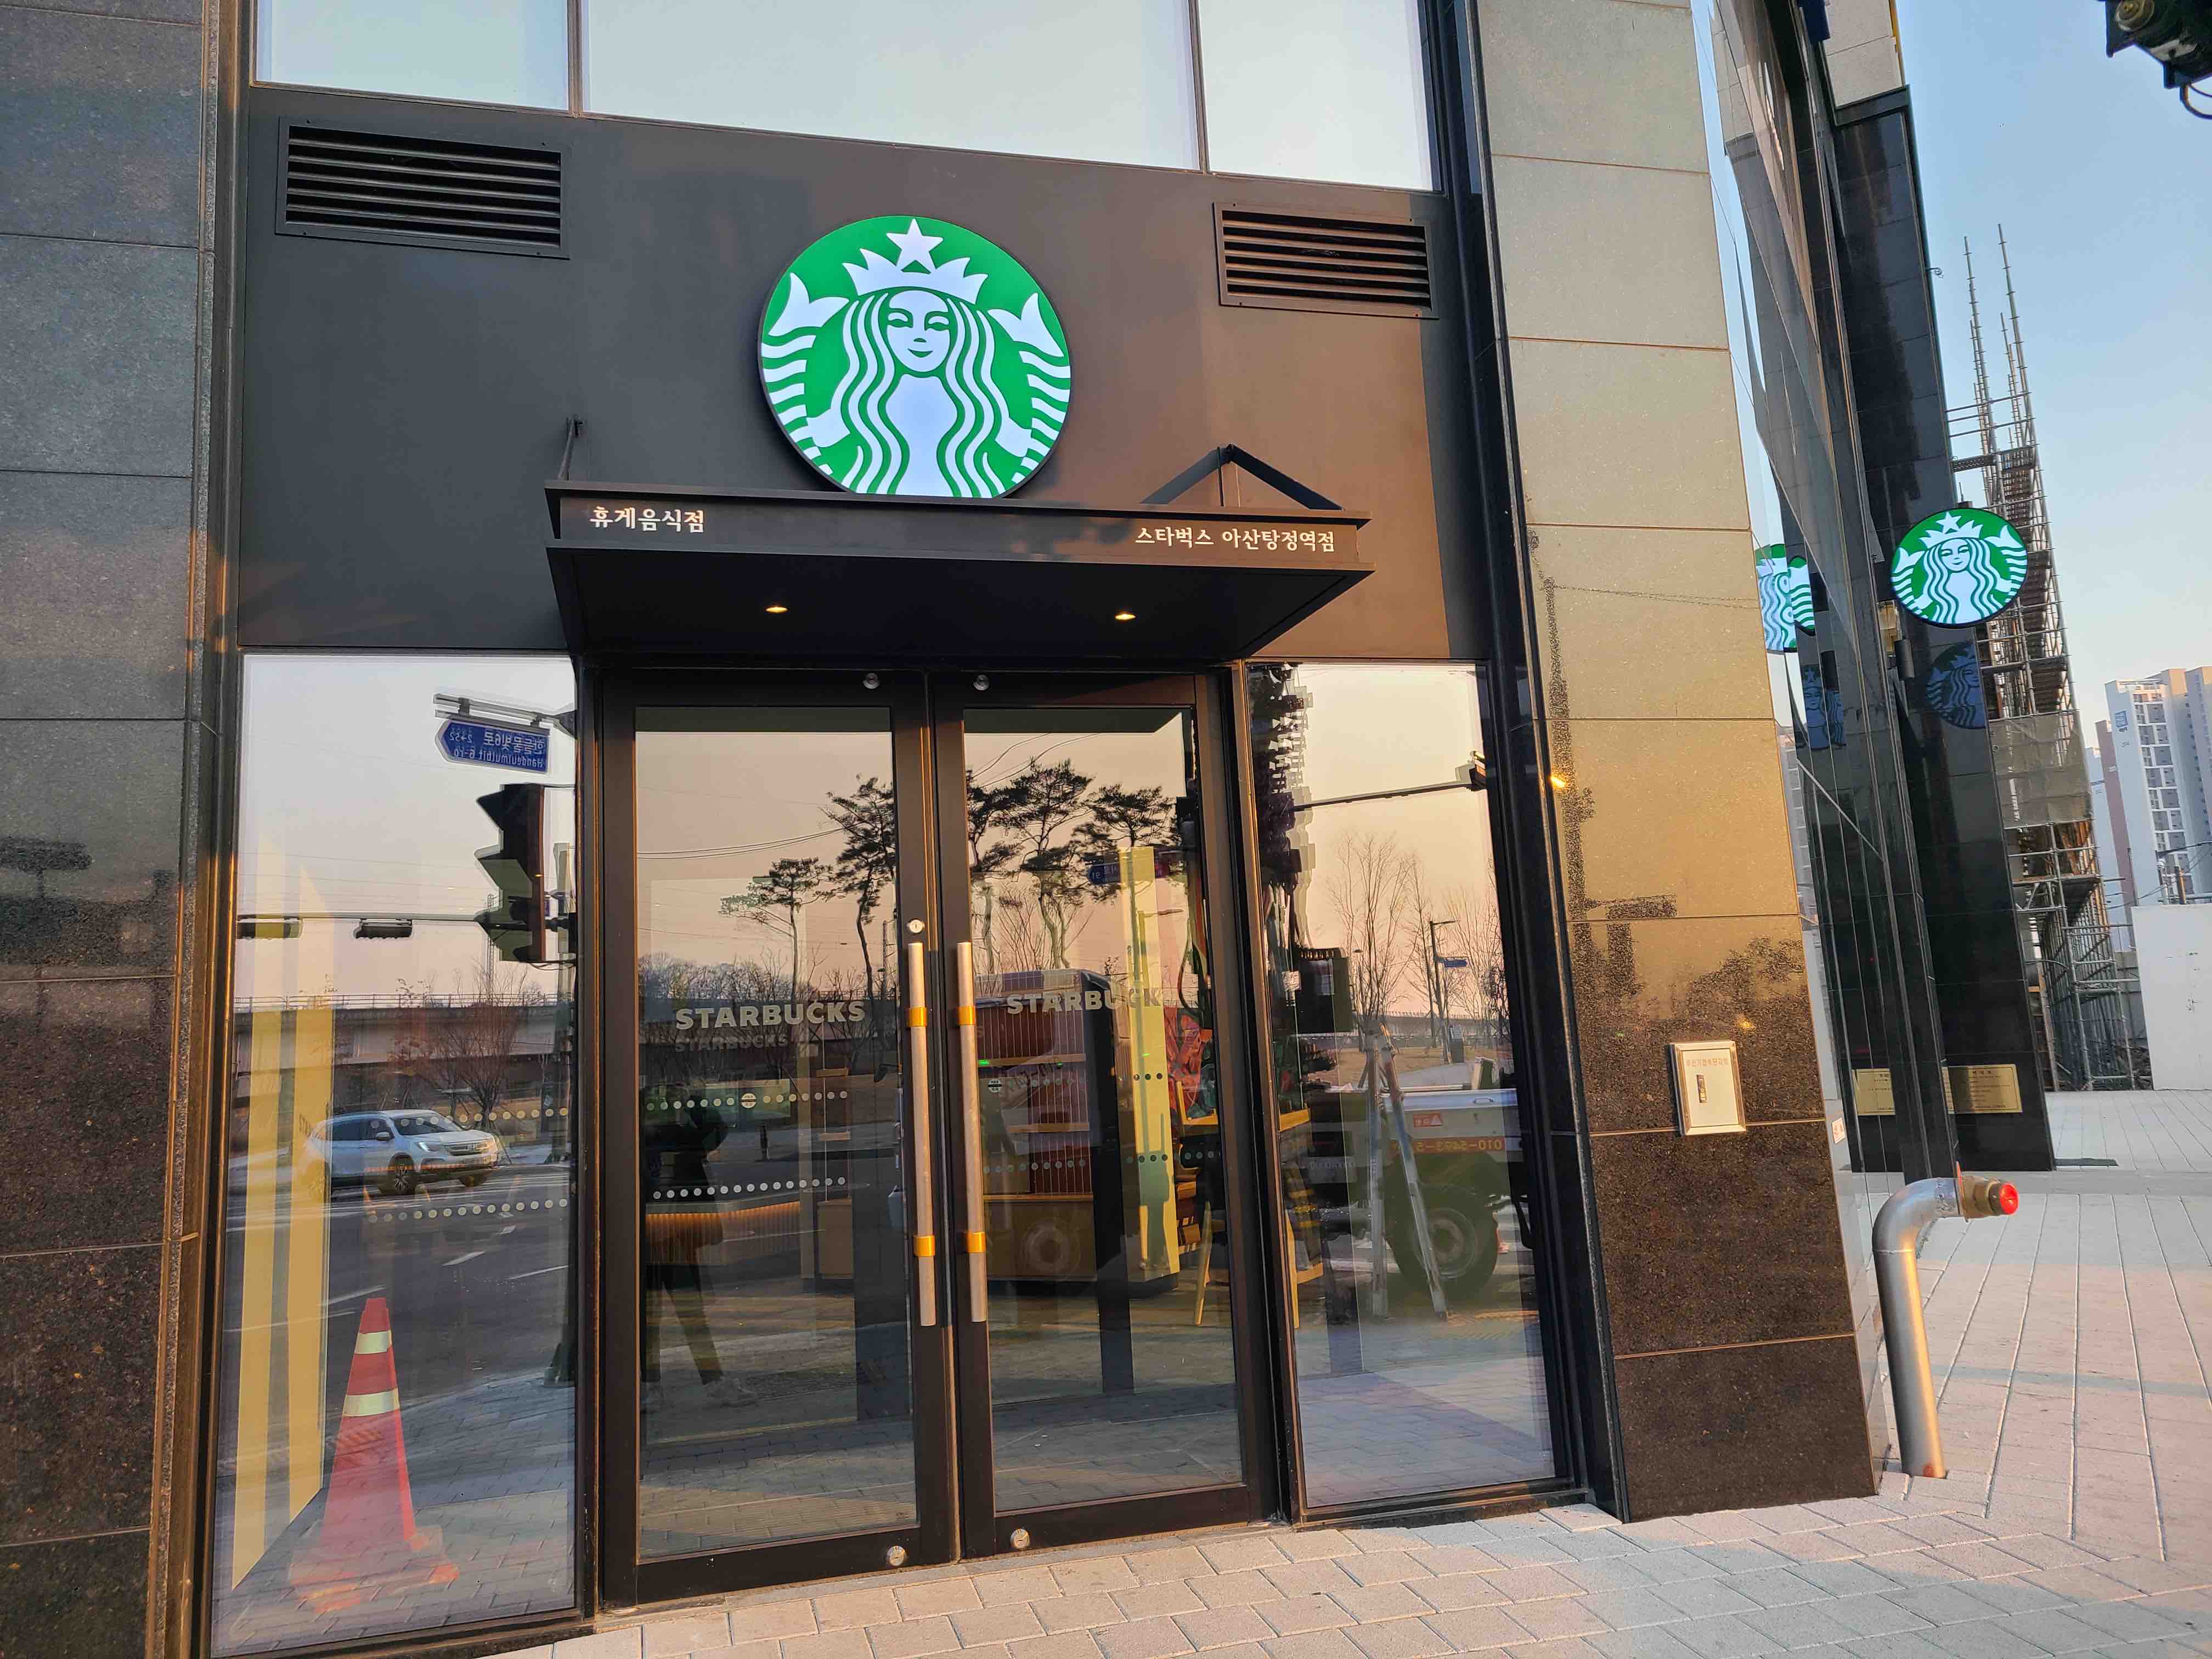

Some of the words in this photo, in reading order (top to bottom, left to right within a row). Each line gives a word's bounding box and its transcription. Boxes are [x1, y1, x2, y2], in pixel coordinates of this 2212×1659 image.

[590, 506, 705, 533] 휴게음식점
[1135, 526, 1214, 548] 스타벅스
[1222, 528, 1335, 552] 아산탕정역점
[1007, 986, 1164, 1014] STARBUCK
[676, 1001, 866, 1030] STARBUCKS
